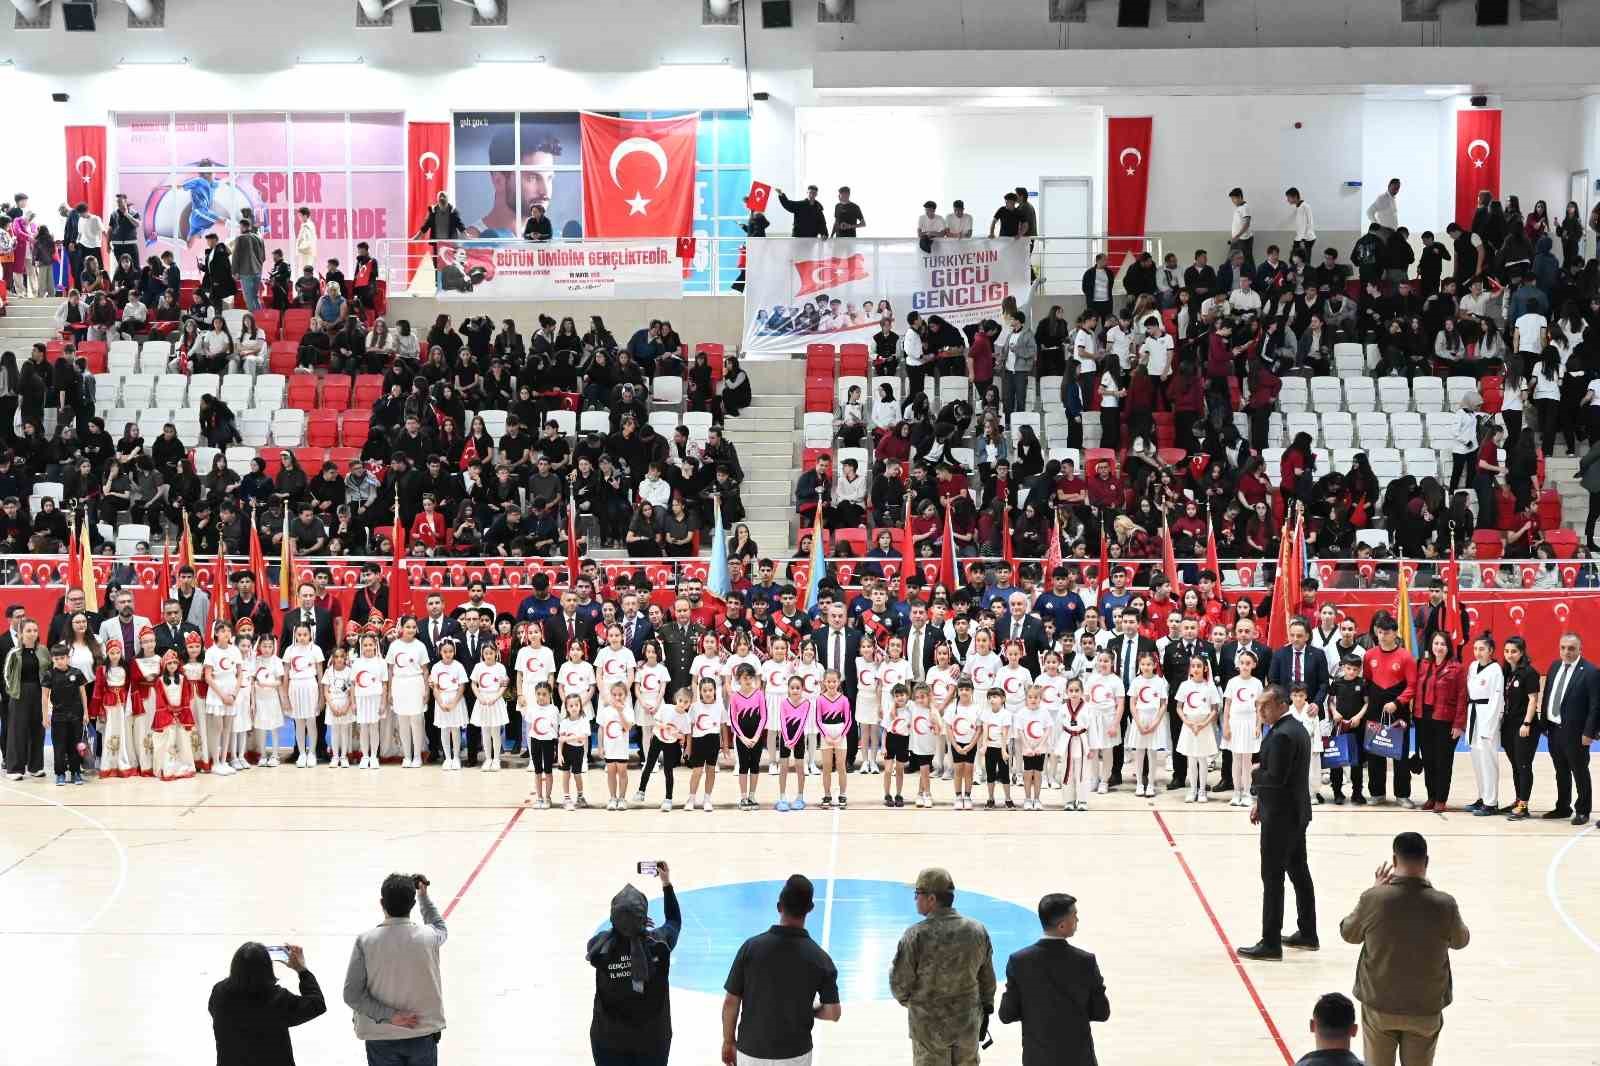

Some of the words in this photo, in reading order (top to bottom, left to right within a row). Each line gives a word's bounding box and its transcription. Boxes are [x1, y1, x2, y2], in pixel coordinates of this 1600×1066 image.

[253, 172, 322, 203] SPOR
[497, 249, 534, 267] BÜTÜN
[538, 248, 584, 267] ÜMİDİM
[931, 265, 990, 288] GÜCÜ
